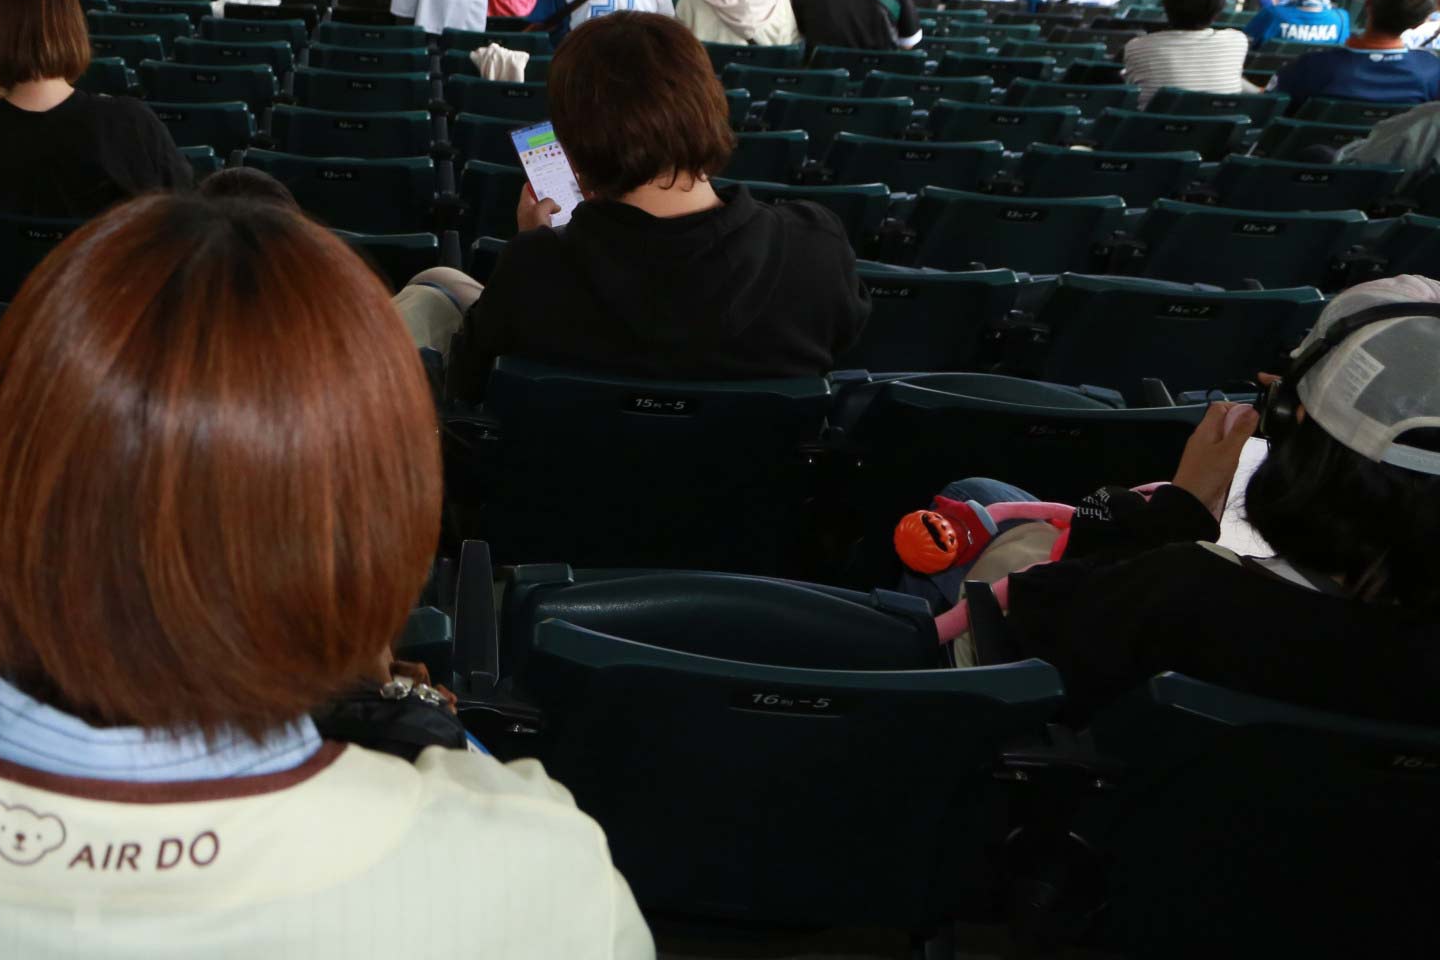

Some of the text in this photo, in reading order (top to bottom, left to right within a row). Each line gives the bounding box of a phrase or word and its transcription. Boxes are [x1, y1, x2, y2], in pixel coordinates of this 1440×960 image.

[1280, 23, 1338, 42] TANAKA
[68, 830, 220, 871] AIR DO
